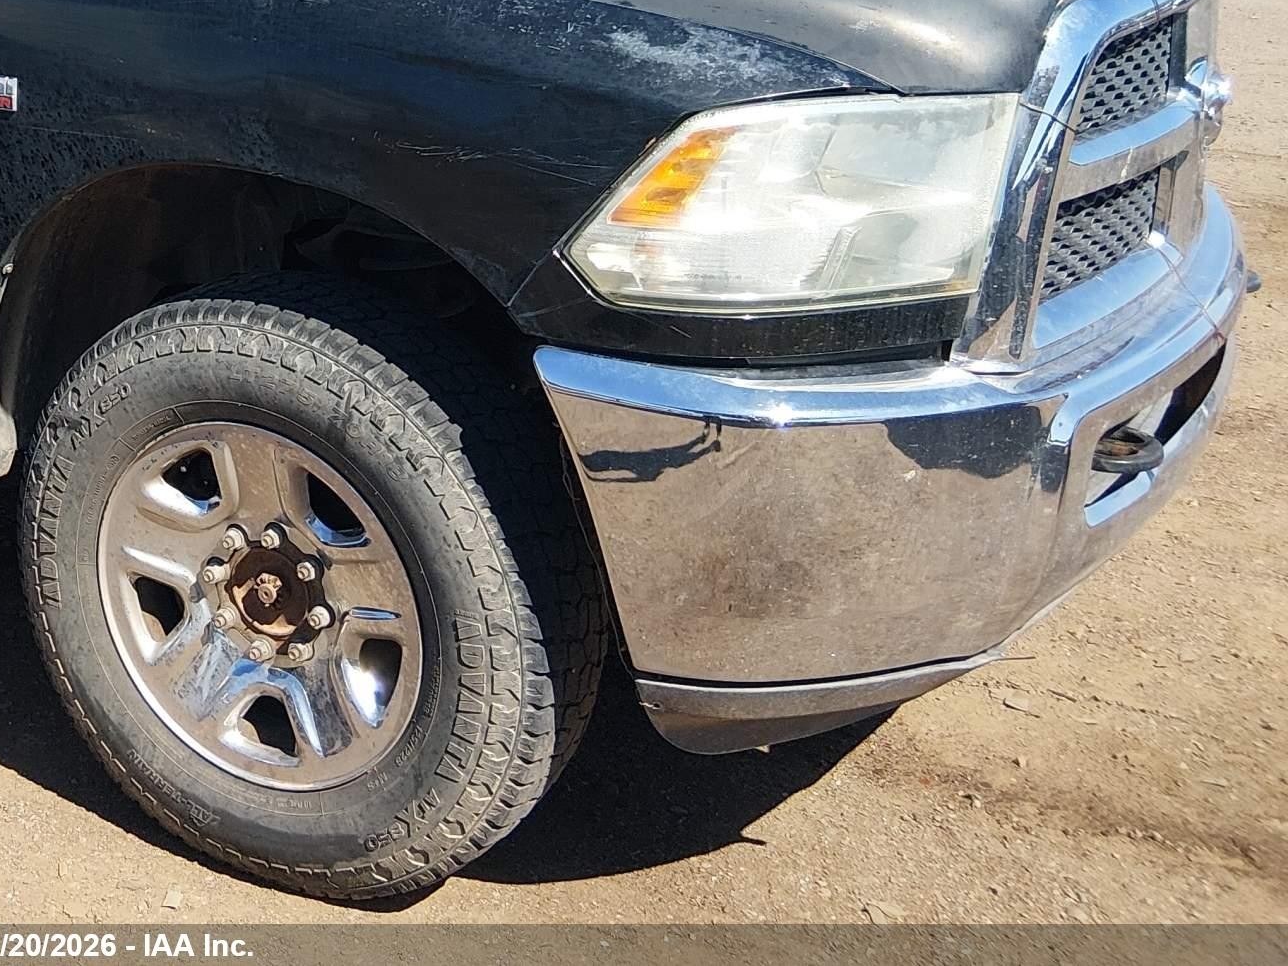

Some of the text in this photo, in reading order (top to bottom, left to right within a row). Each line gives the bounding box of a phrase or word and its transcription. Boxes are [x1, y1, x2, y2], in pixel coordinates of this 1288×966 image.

[40, 455, 76, 610] ADVANTA
[435, 616, 487, 783] ADVANTA
[127, 748, 222, 827] ALL-TERRAIN
